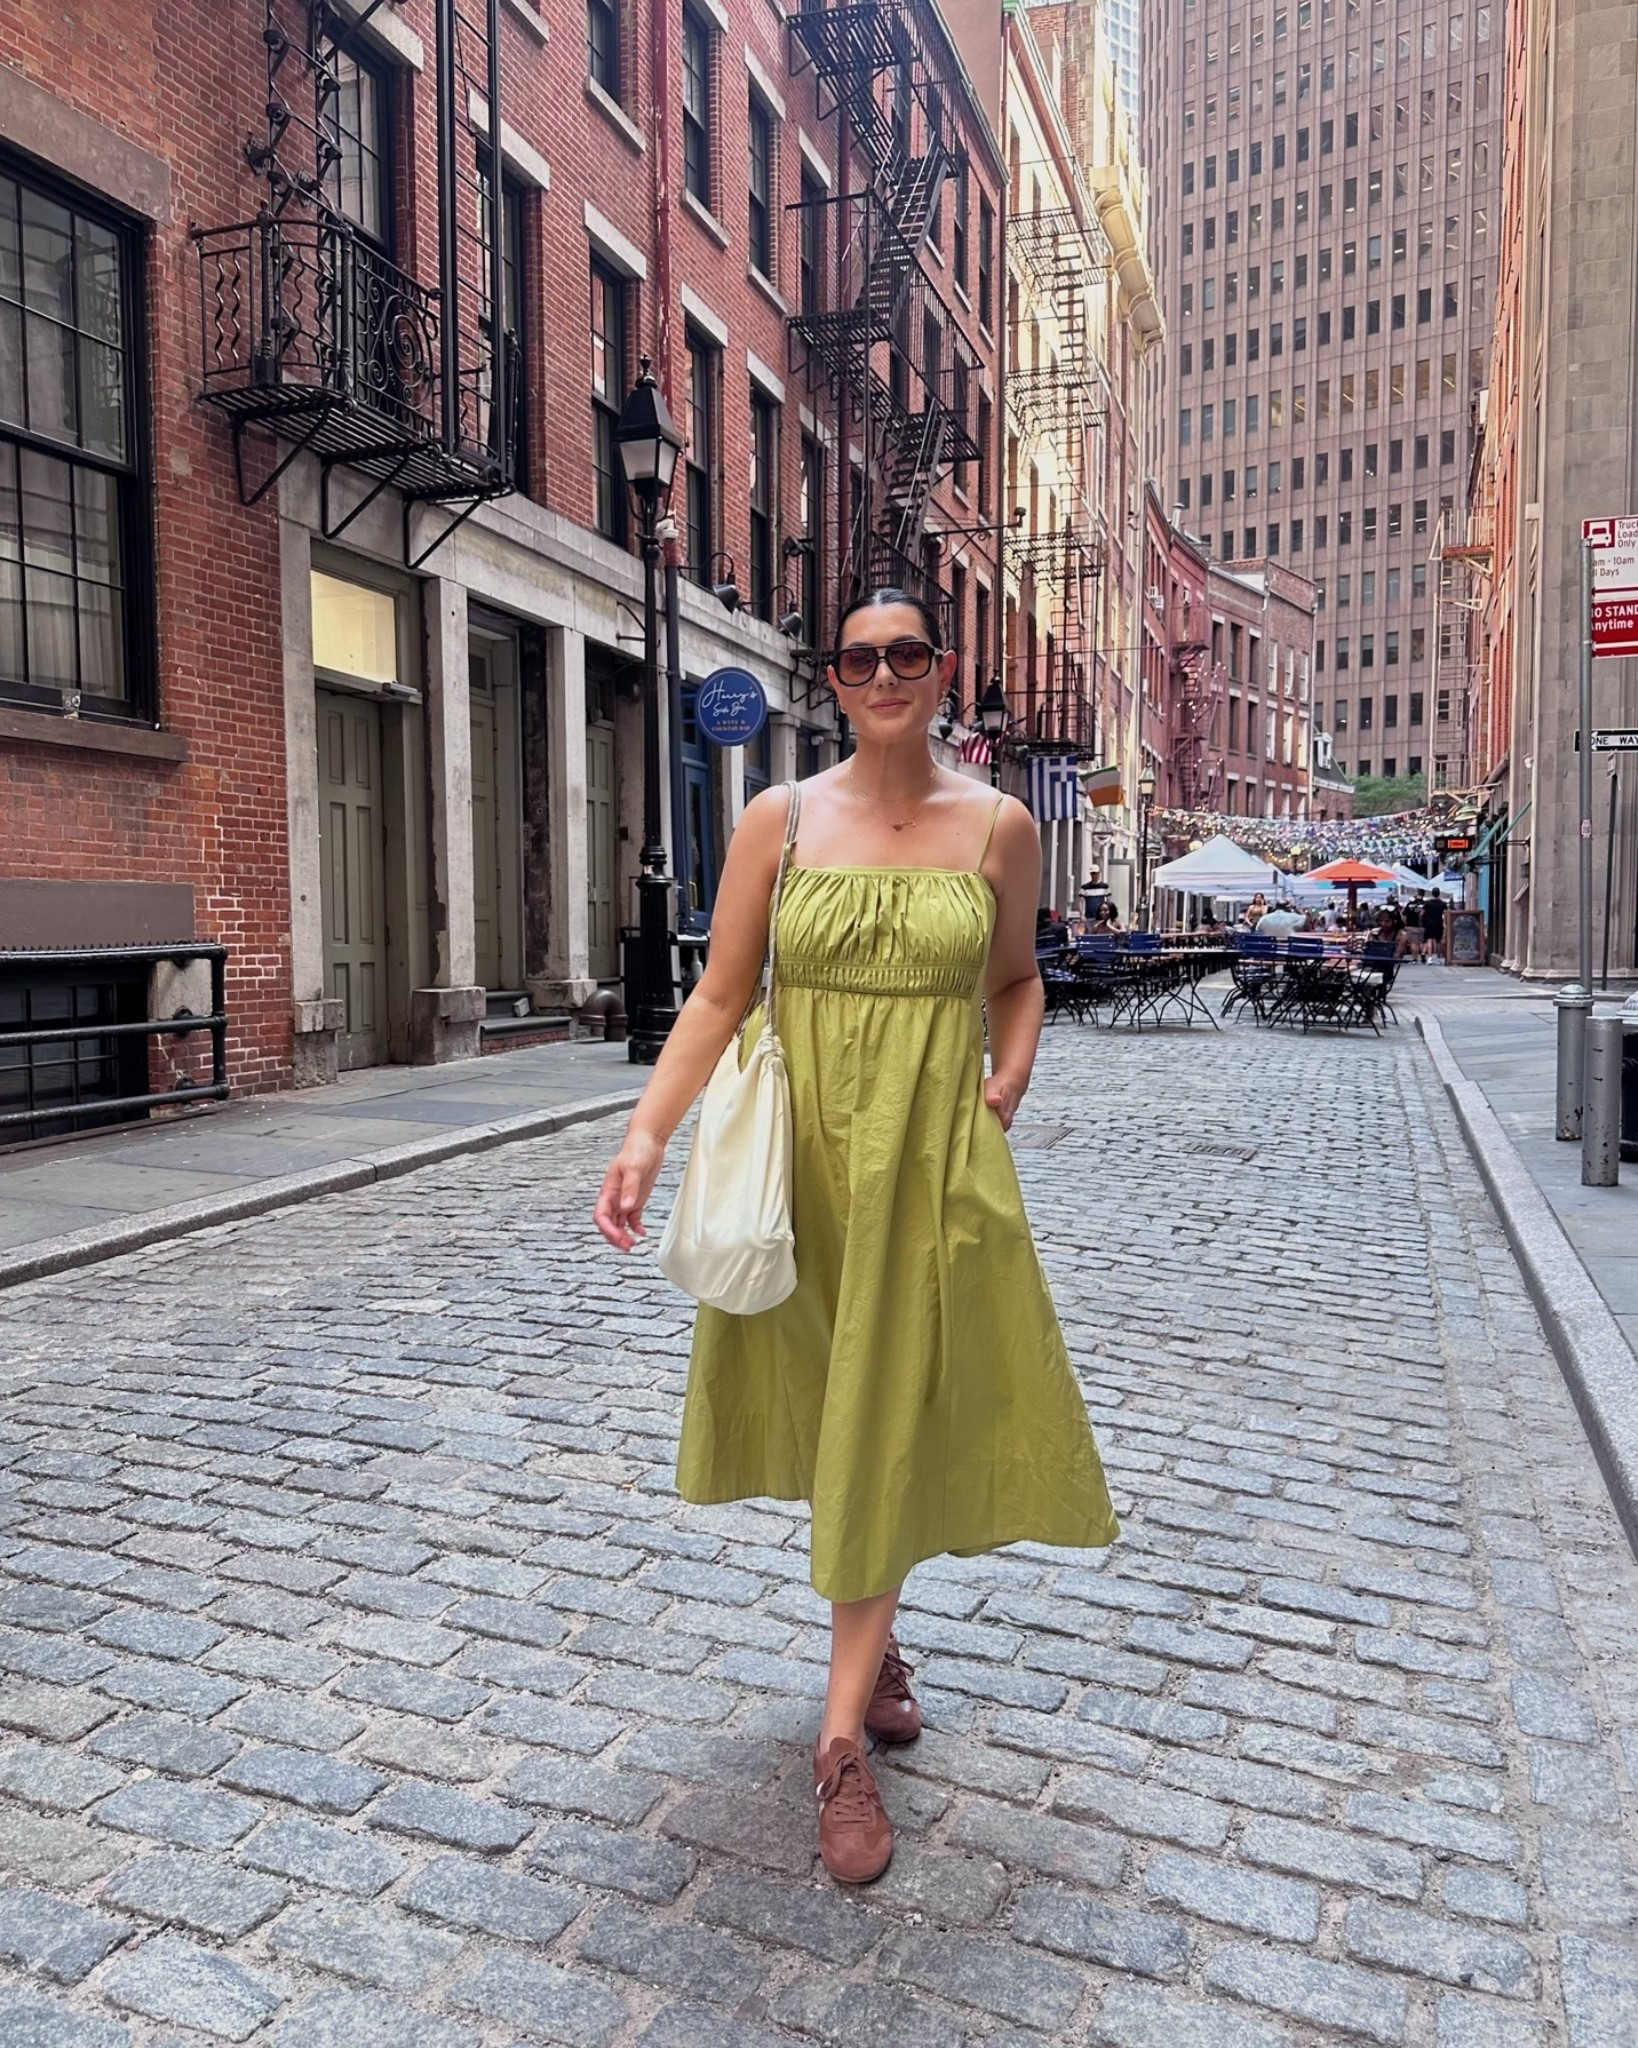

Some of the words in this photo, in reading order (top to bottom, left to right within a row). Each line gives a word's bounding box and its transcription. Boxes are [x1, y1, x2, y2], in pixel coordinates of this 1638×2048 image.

[1618, 539, 1636, 548] Only
[1613, 556, 1634, 565] 10am
[1600, 568, 1620, 578] Days
